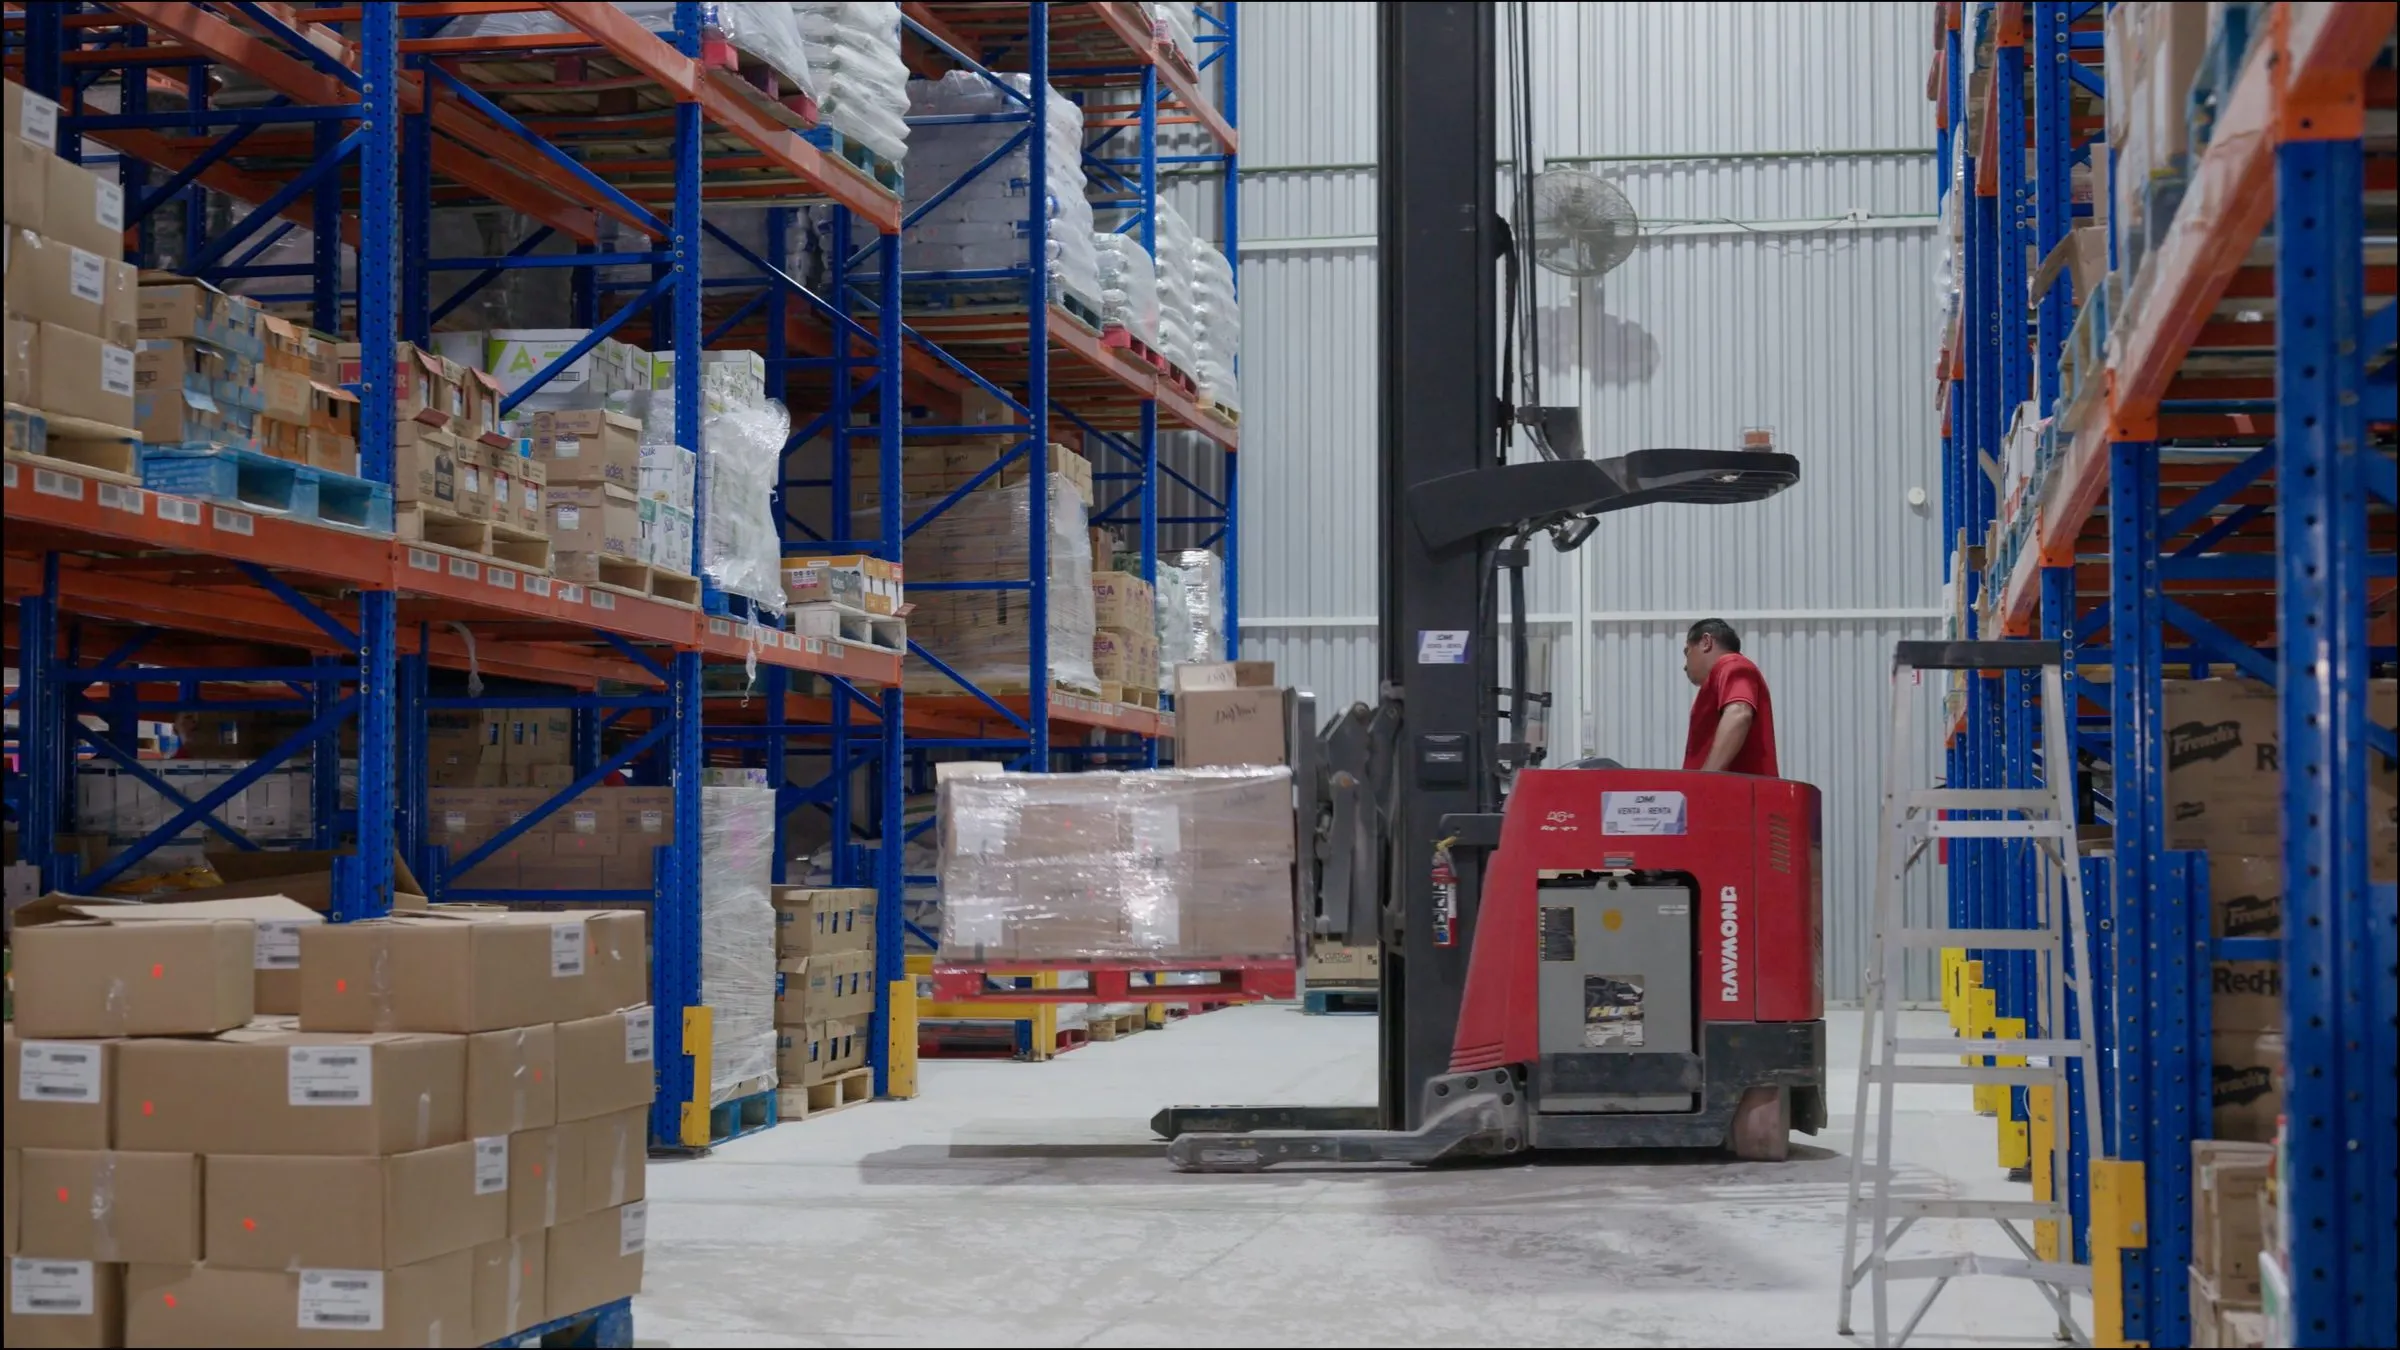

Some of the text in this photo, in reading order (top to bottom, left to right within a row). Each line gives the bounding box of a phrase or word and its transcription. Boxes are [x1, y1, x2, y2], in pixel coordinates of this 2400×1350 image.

[640, 446, 656, 458] Silk
[1617, 806, 1672, 815] VENTA RENTA
[1720, 885, 1739, 1002] RAYMOND
[2213, 966, 2282, 997] RedH
[2213, 1070, 2270, 1098] rench's
